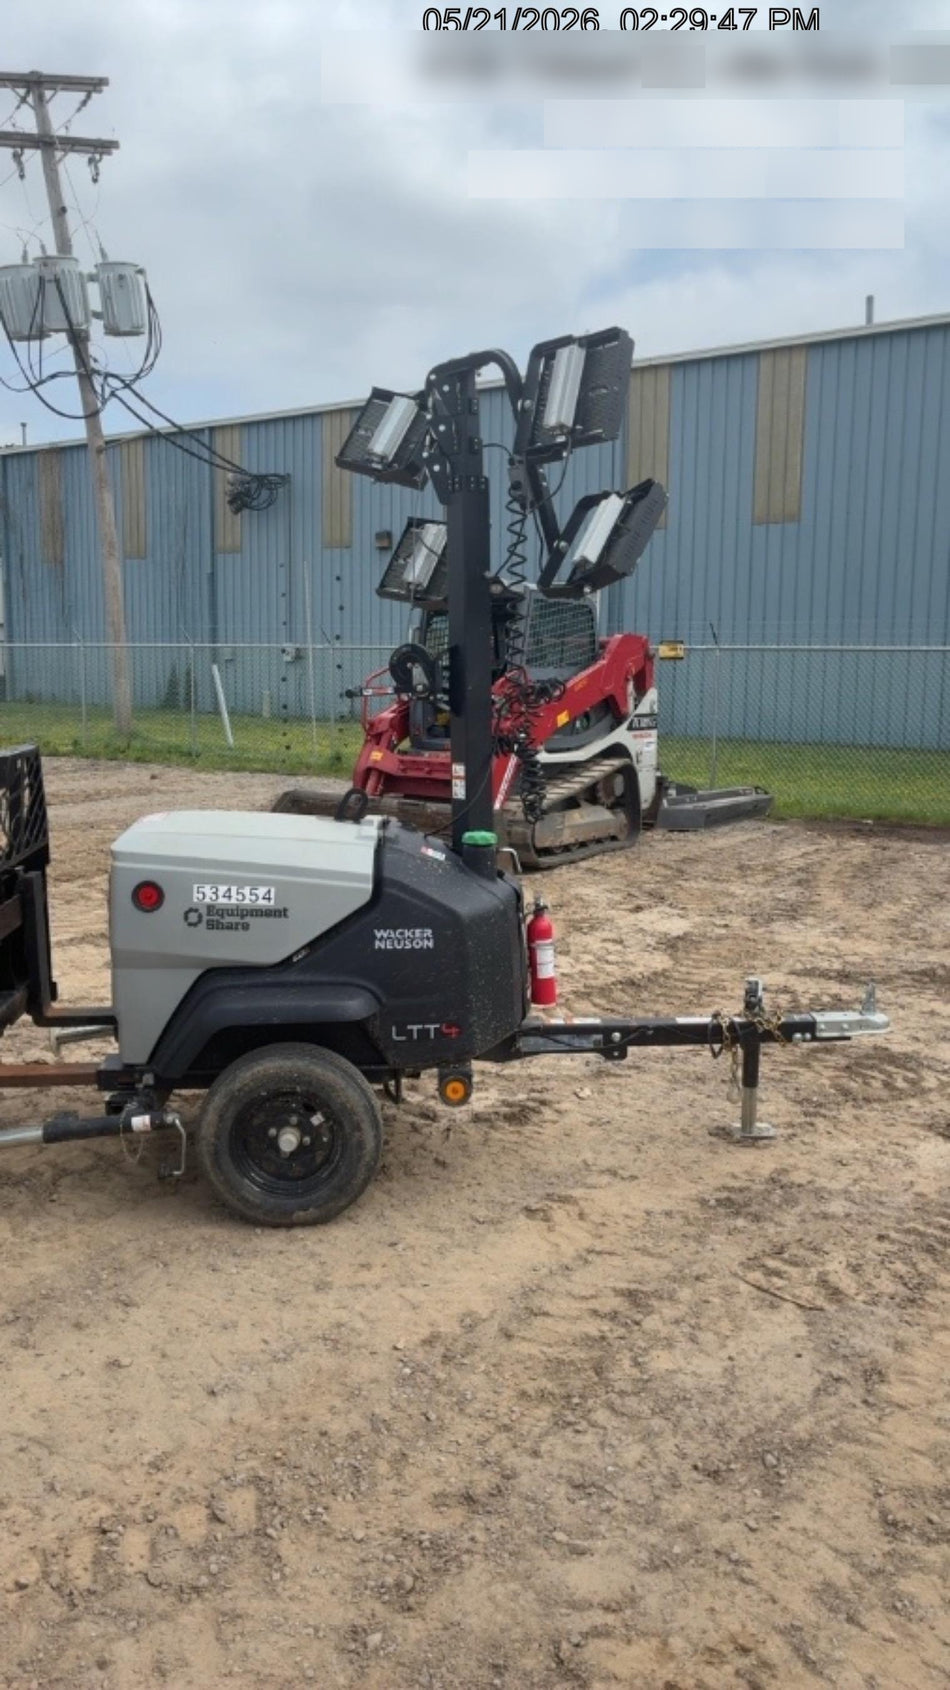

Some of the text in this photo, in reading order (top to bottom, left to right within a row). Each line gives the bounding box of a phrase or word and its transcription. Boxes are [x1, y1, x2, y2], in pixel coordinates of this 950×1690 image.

[196, 886, 273, 903] 534554
[206, 905, 289, 920] Equipment
[206, 919, 250, 931] Share
[374, 929, 433, 938] WACKER
[375, 939, 434, 949] NEUSON
[391, 1023, 461, 1040] LTT4
